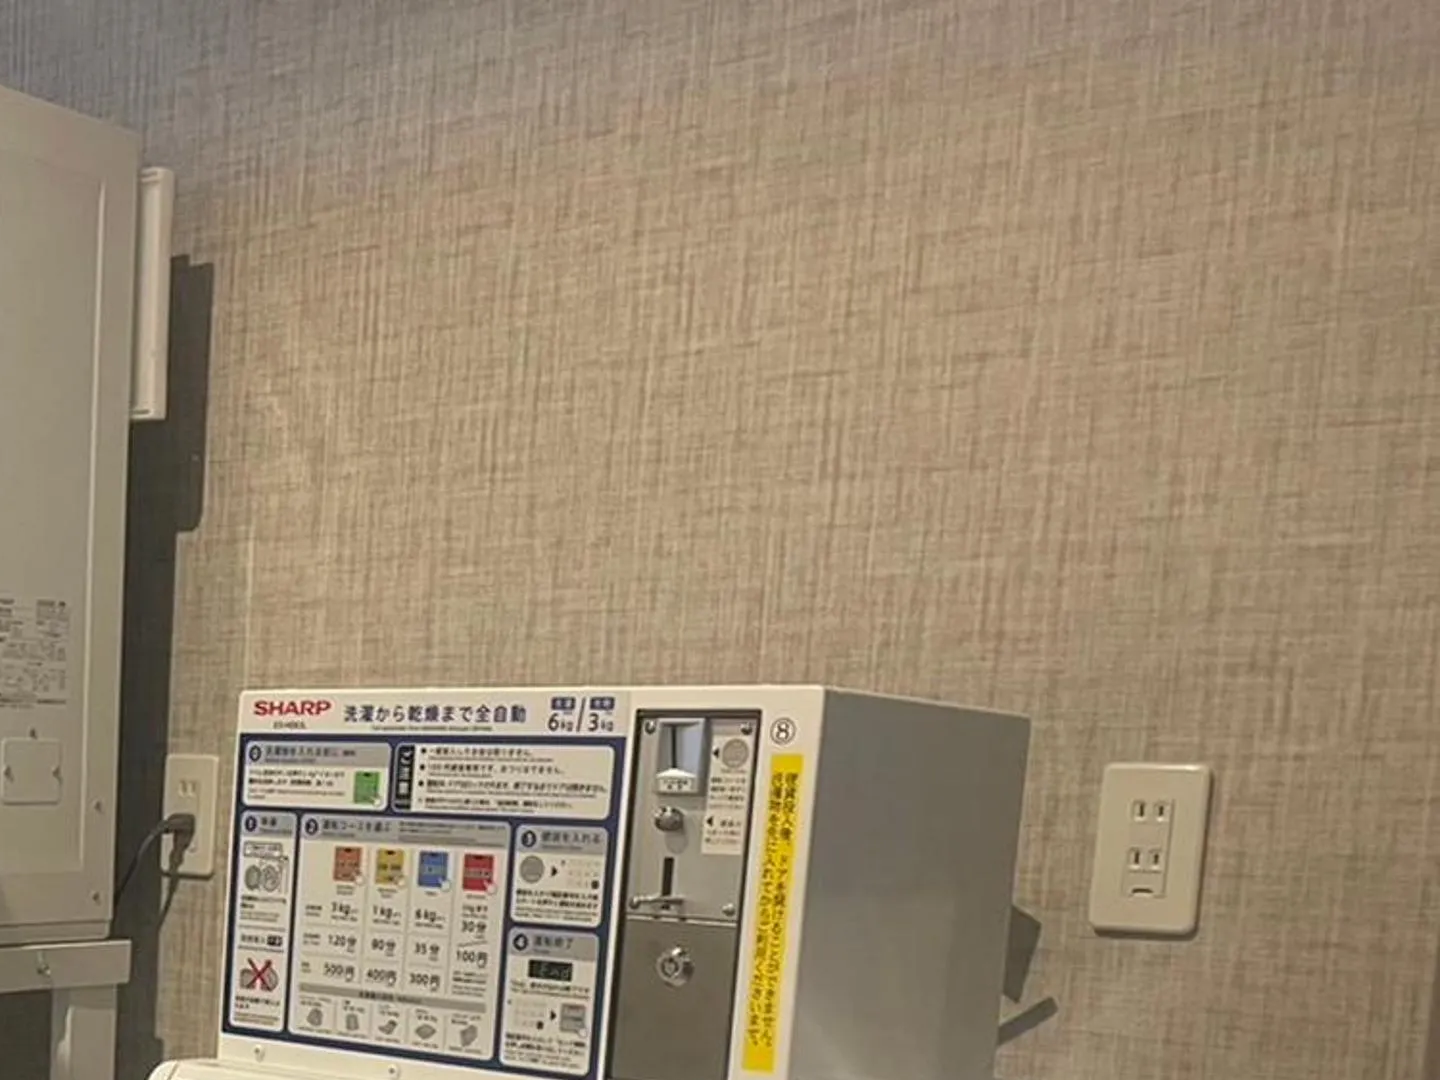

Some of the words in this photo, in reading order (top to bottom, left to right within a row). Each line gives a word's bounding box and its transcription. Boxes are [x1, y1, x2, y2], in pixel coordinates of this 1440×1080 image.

[255, 699, 332, 717] SHARP
[344, 703, 527, 725] 洗濯から乾燥まで全自動
